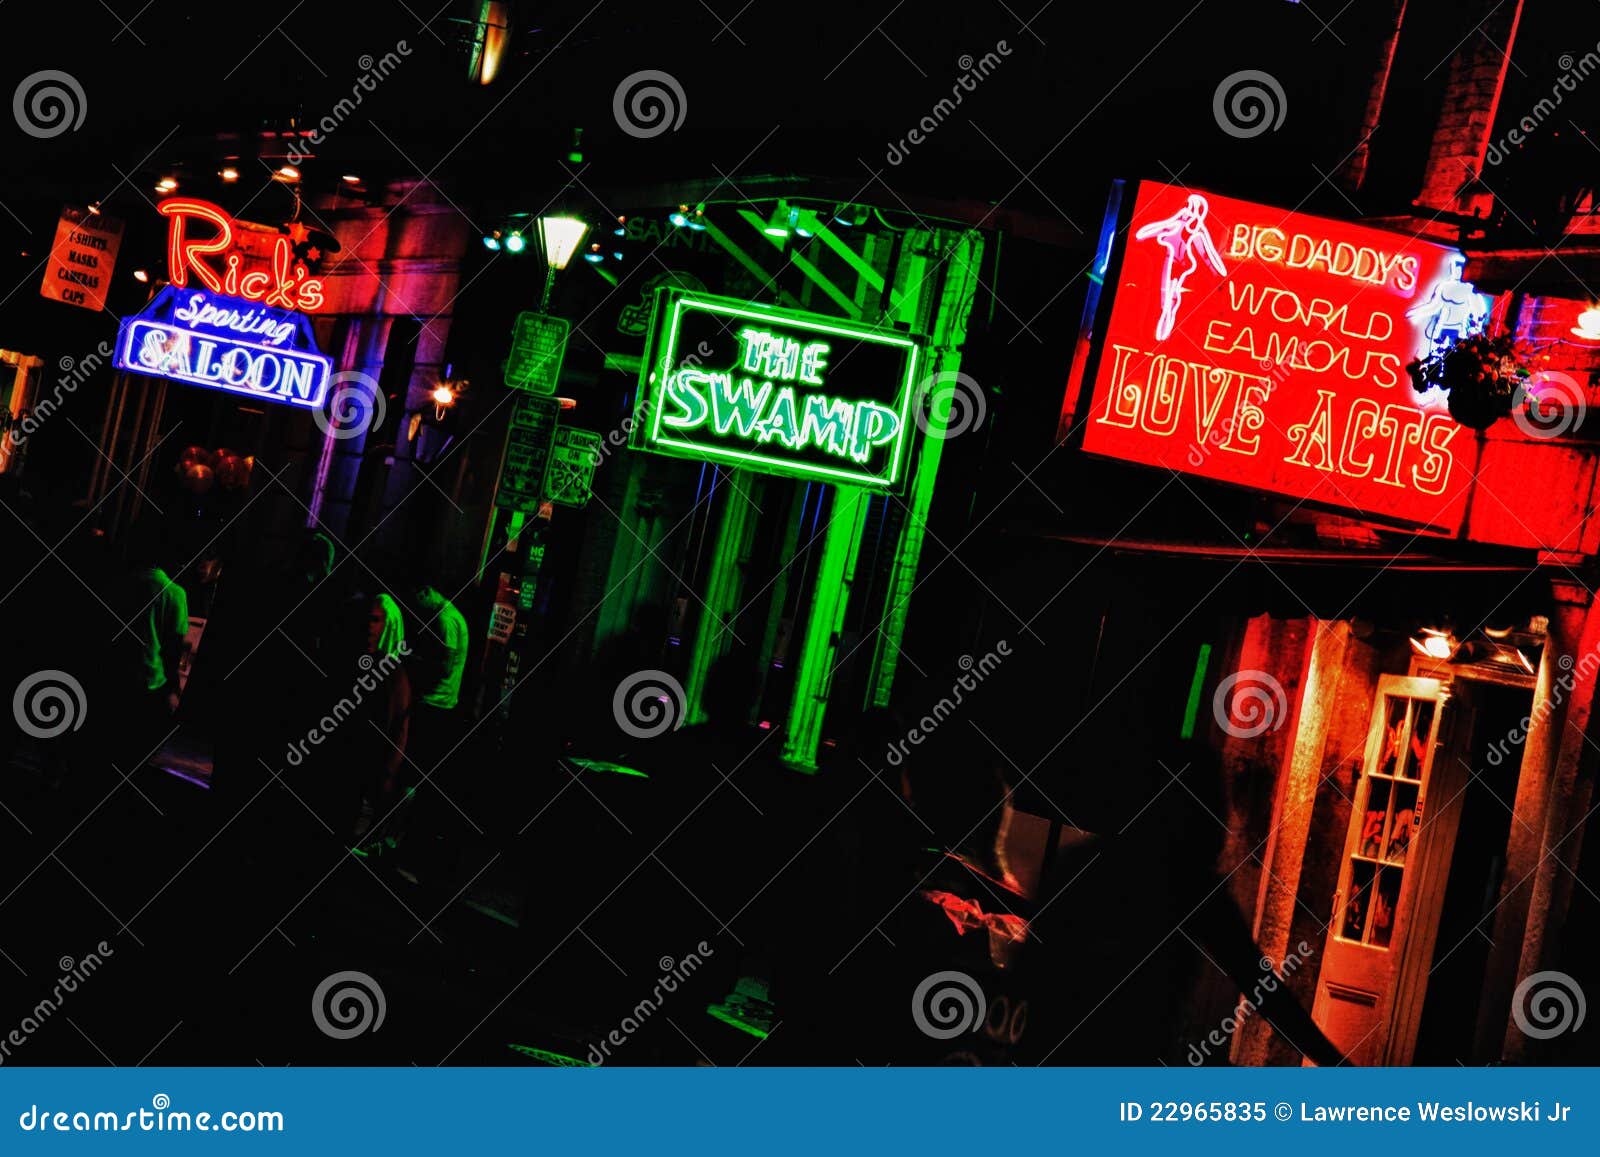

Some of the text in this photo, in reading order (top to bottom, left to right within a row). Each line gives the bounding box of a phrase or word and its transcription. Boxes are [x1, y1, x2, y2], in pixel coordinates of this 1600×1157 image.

[58, 267, 99, 289] CAMERAS
[68, 250, 98, 268] MASKS
[158, 200, 325, 312] Rick's
[1230, 223, 1418, 291] BIG DADDY'S
[62, 288, 85, 304] CAPS
[175, 294, 297, 346] Sporting
[1228, 280, 1393, 341] WORLD
[139, 328, 317, 401] SALOON
[741, 328, 830, 385] THE
[663, 368, 901, 464] SWAMP
[1097, 344, 1271, 456] LOVE
[1284, 389, 1462, 496] ACTS
